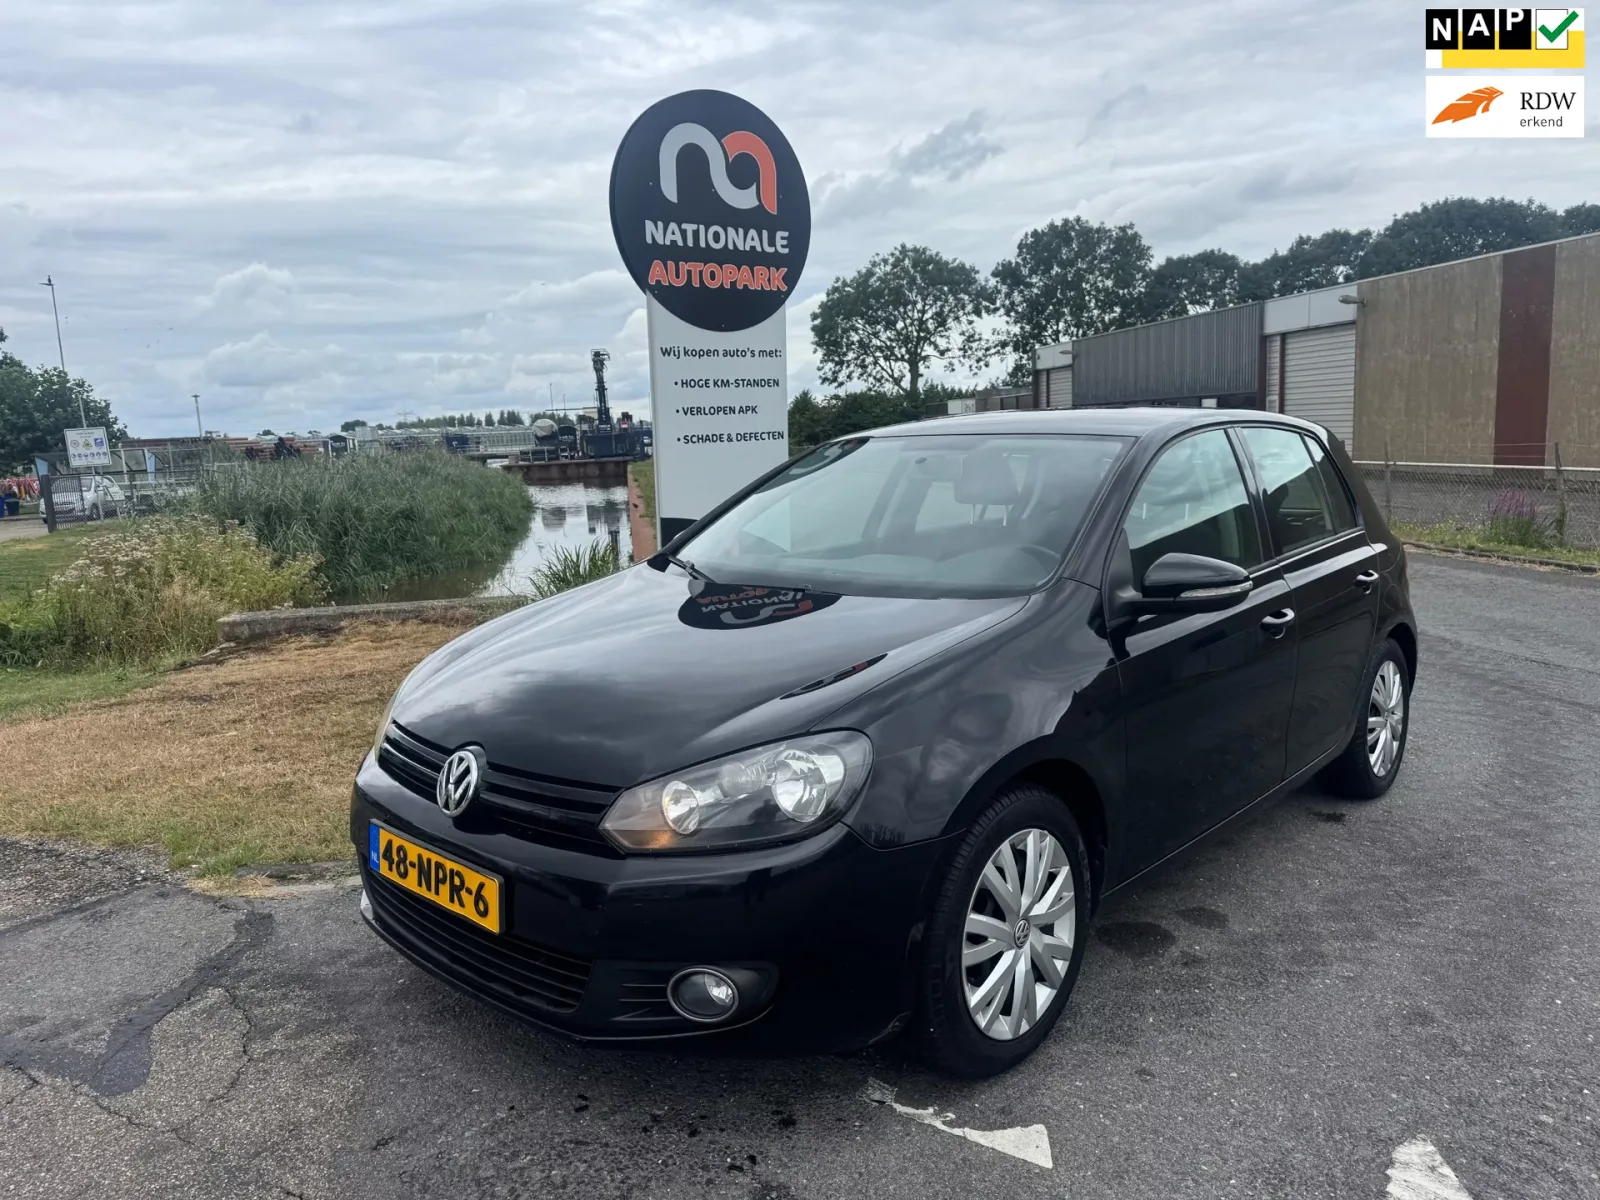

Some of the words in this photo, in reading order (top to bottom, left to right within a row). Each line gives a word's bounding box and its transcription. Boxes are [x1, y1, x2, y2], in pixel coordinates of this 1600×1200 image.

[645, 220, 789, 254] NATIONALE
[648, 259, 788, 291] AUTOPARK
[660, 346, 681, 359] Wij
[683, 346, 720, 359] kopen
[722, 347, 756, 358] auto's
[758, 349, 782, 358] met:
[681, 378, 710, 388] HOGE
[713, 378, 780, 388] KM-STANDEN
[682, 405, 736, 416] VERLOPEN
[738, 405, 758, 415] APK
[683, 433, 725, 444] SCHADE
[726, 433, 734, 443] &
[735, 431, 785, 442] DEFECTEN
[371, 850, 379, 864] NL
[382, 839, 488, 918] 48-NPR-6
